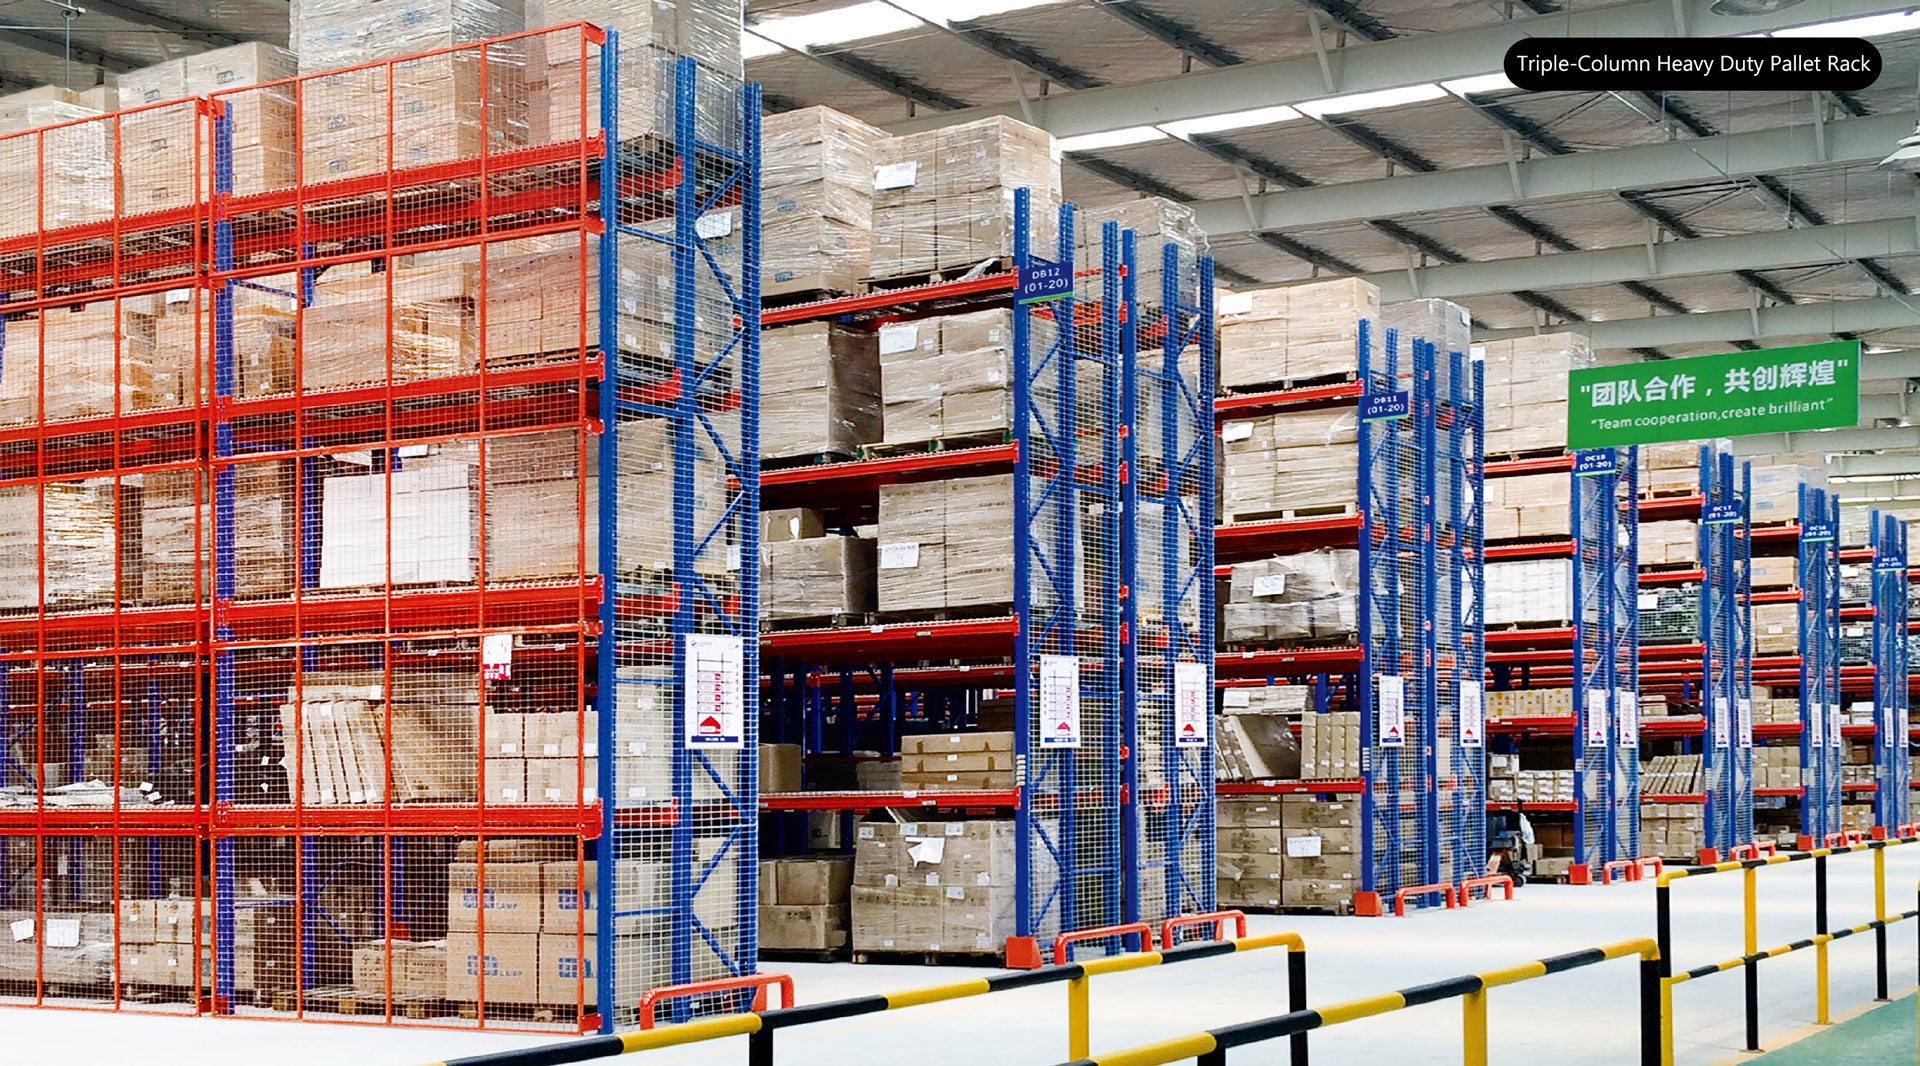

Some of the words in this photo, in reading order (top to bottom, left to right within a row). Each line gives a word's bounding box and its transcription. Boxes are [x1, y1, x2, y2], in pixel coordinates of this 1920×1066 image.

[1032, 267, 1060, 280] DB12
[1024, 278, 1069, 295] (01-20)
[1367, 403, 1405, 415] (01-20)
